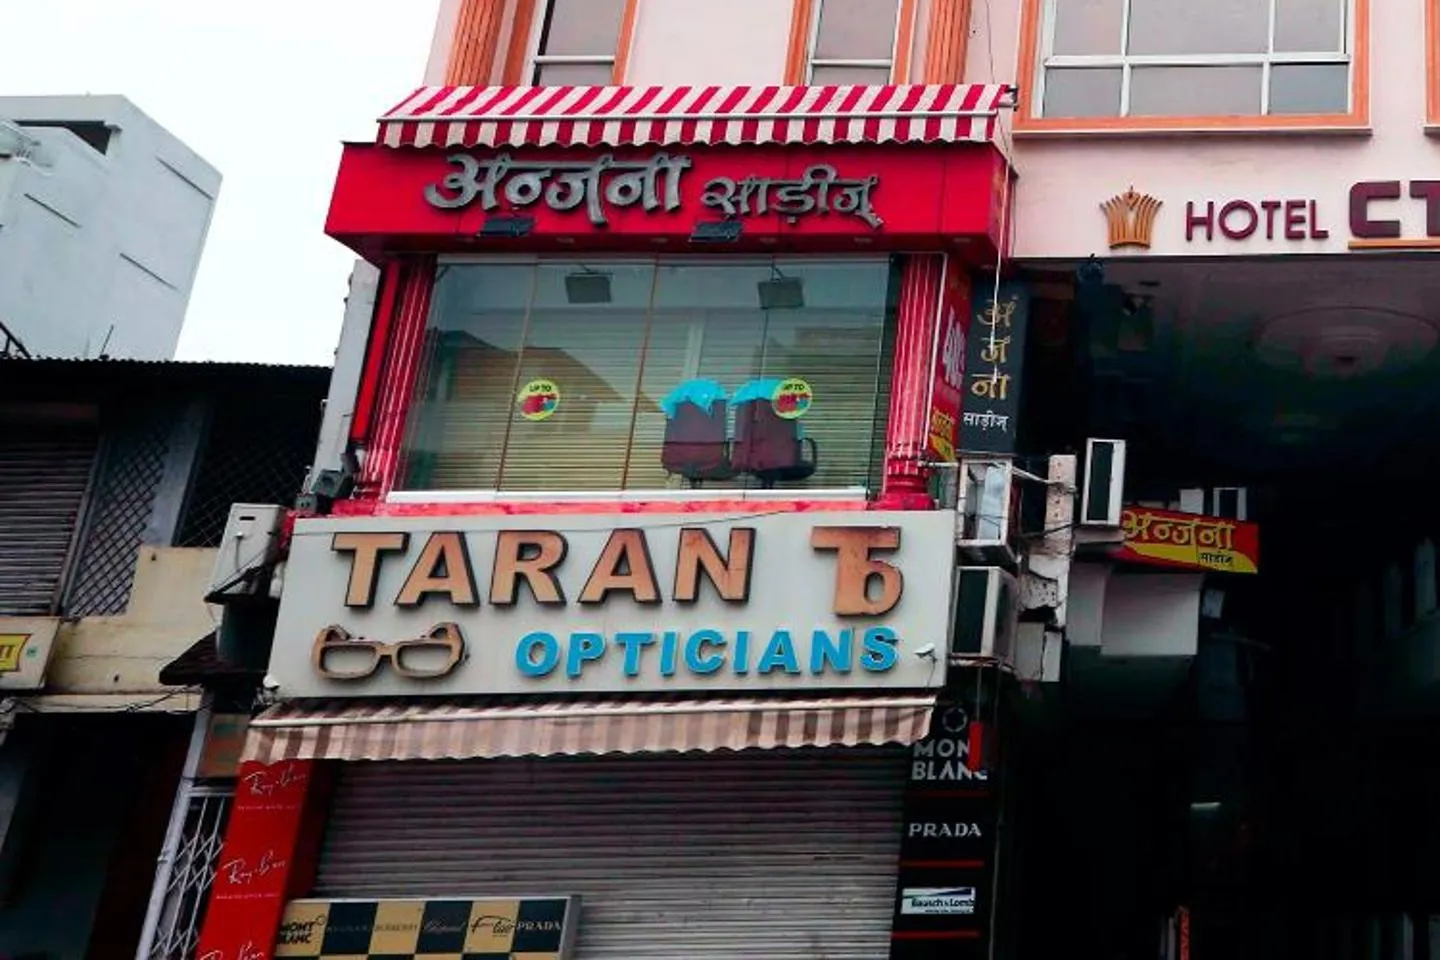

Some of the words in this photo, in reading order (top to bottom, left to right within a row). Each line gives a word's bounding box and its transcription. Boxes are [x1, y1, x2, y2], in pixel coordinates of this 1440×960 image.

[1185, 199, 1330, 241] HOTEL
[332, 526, 757, 608] TARAN
[514, 626, 899, 678] OPTICIANS
[908, 822, 982, 838] PRADA
